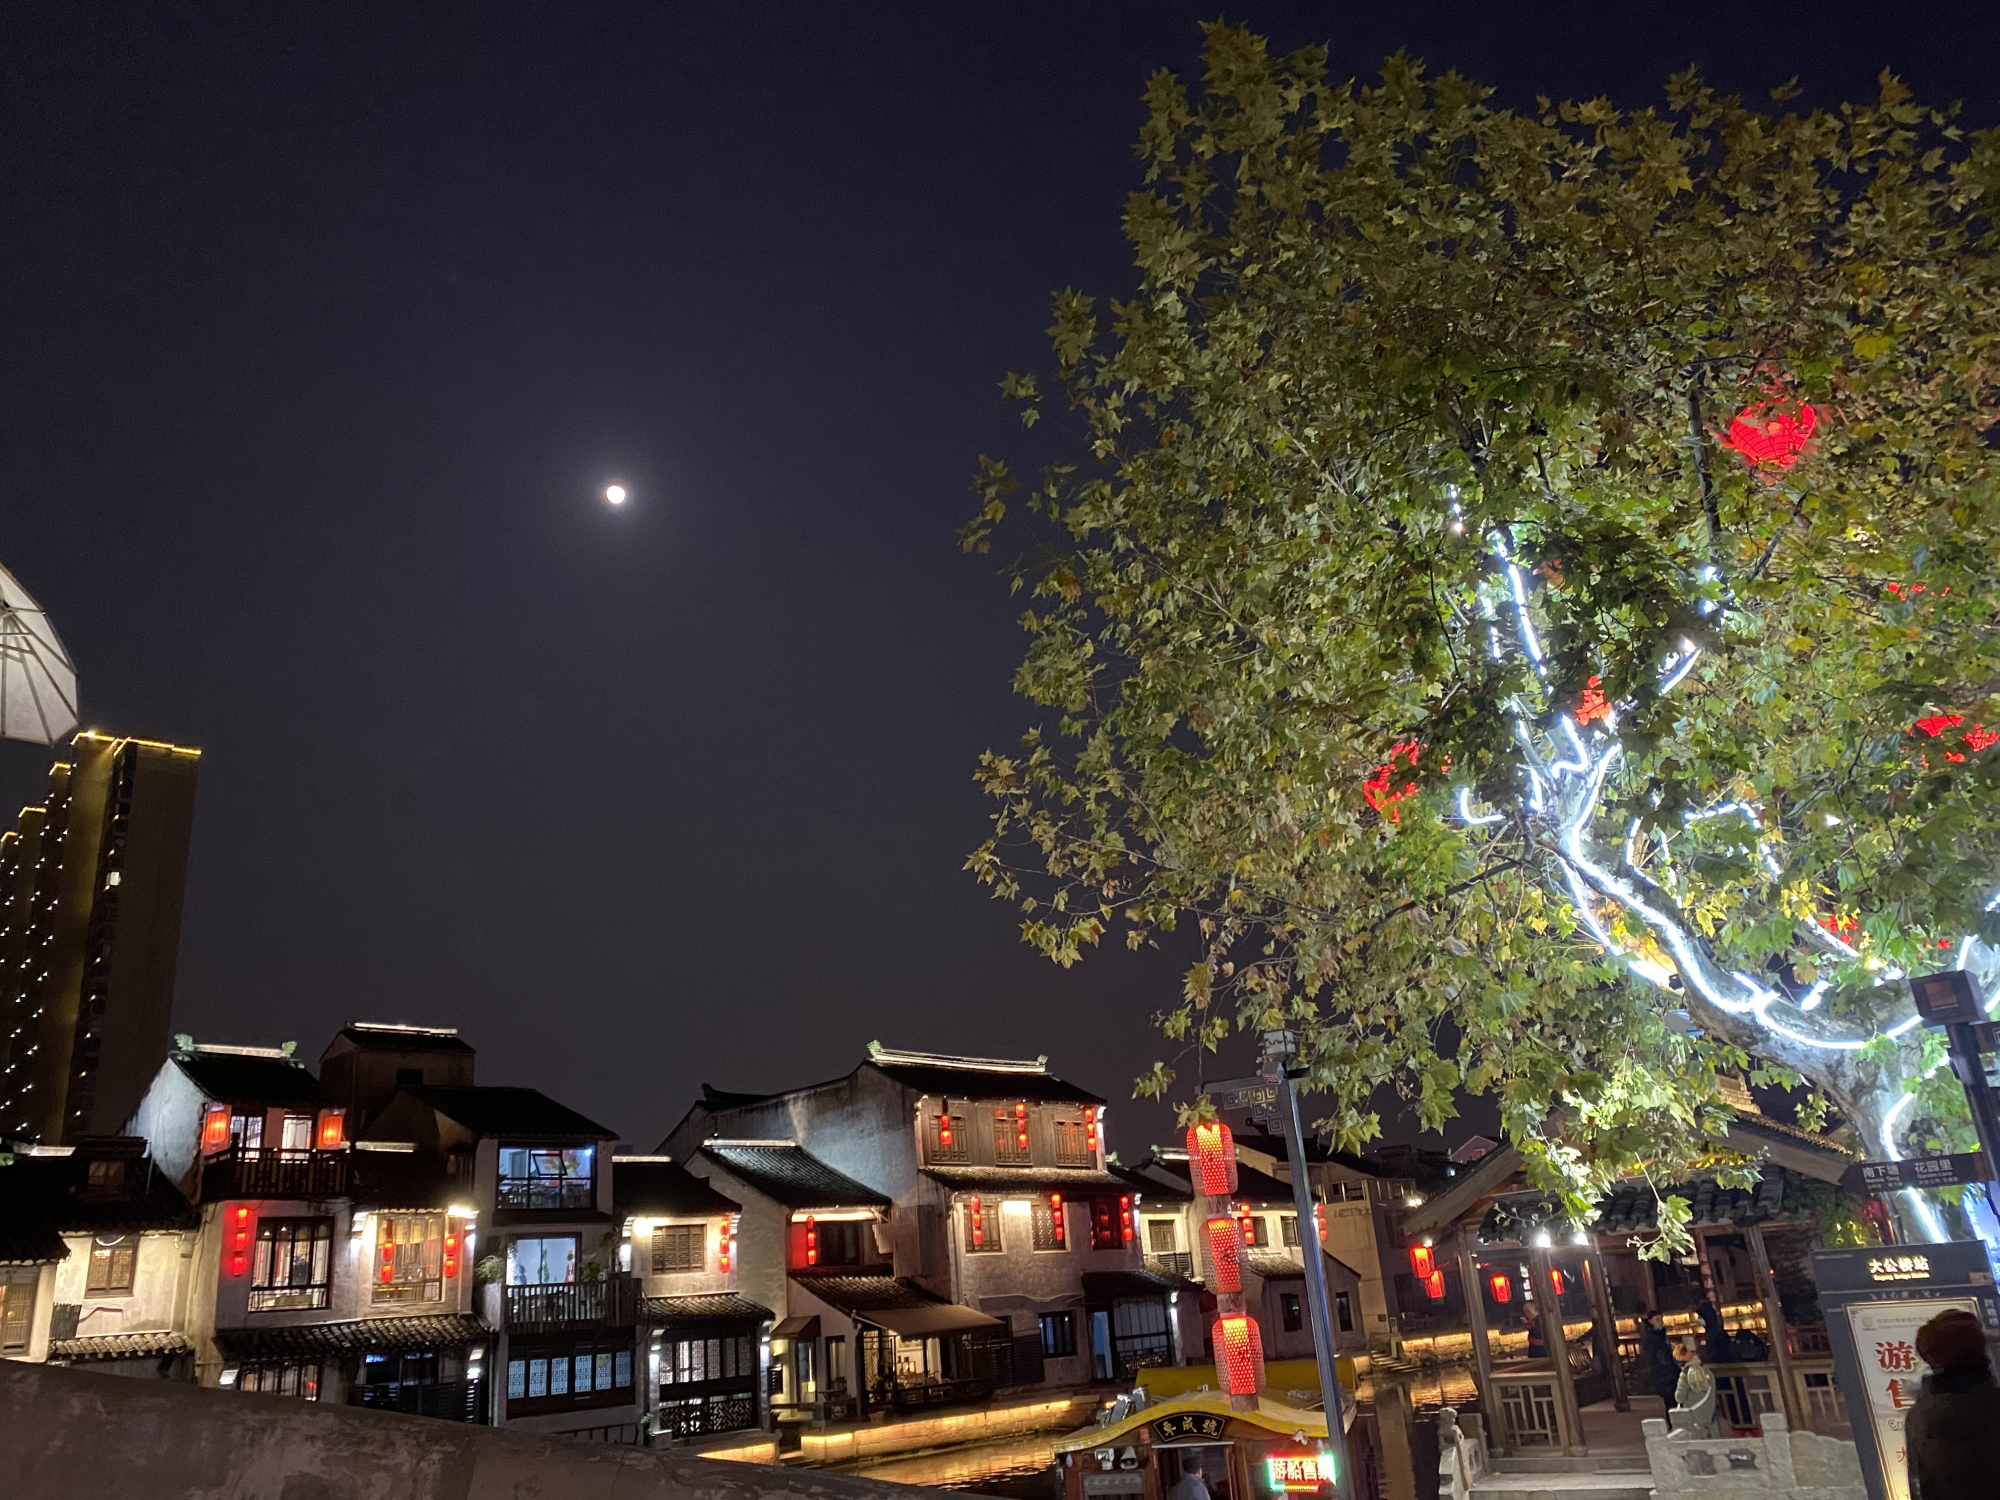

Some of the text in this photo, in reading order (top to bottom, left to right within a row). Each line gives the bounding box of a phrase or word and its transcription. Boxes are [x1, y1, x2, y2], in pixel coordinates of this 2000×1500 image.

[1862, 1164, 1900, 1178] 南下塘
[1914, 1160, 1953, 1173] 花园里
[1868, 1256, 1929, 1273] 大公桥站
